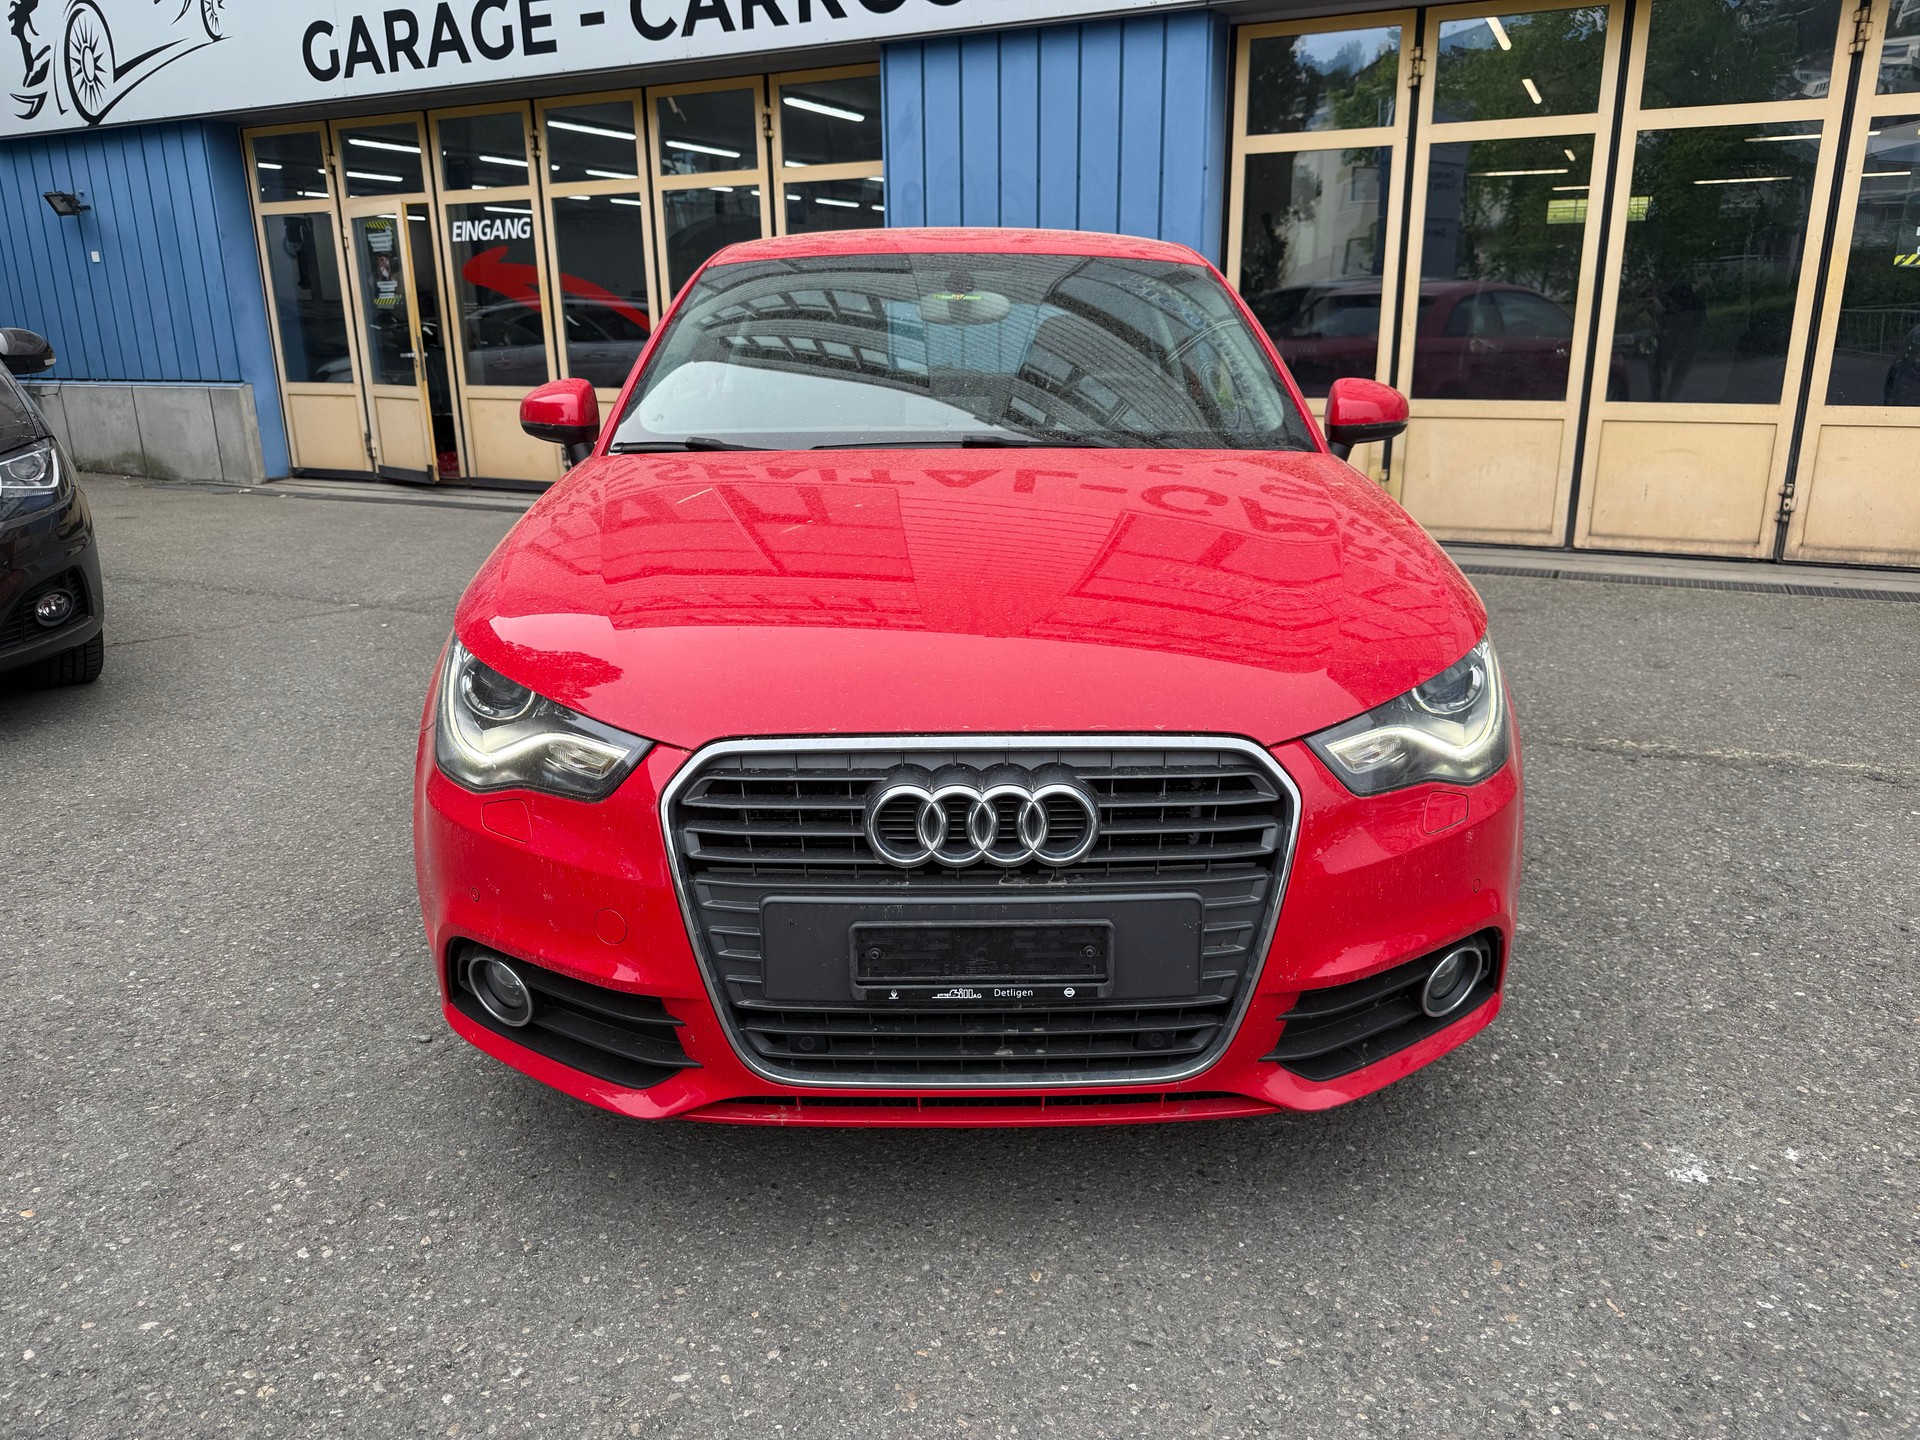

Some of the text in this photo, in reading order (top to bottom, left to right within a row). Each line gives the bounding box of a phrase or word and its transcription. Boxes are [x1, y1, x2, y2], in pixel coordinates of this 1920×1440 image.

[302, 0, 558, 82] GARAGE
[452, 217, 531, 242] EINGANG
[994, 988, 1033, 998] Detligen
